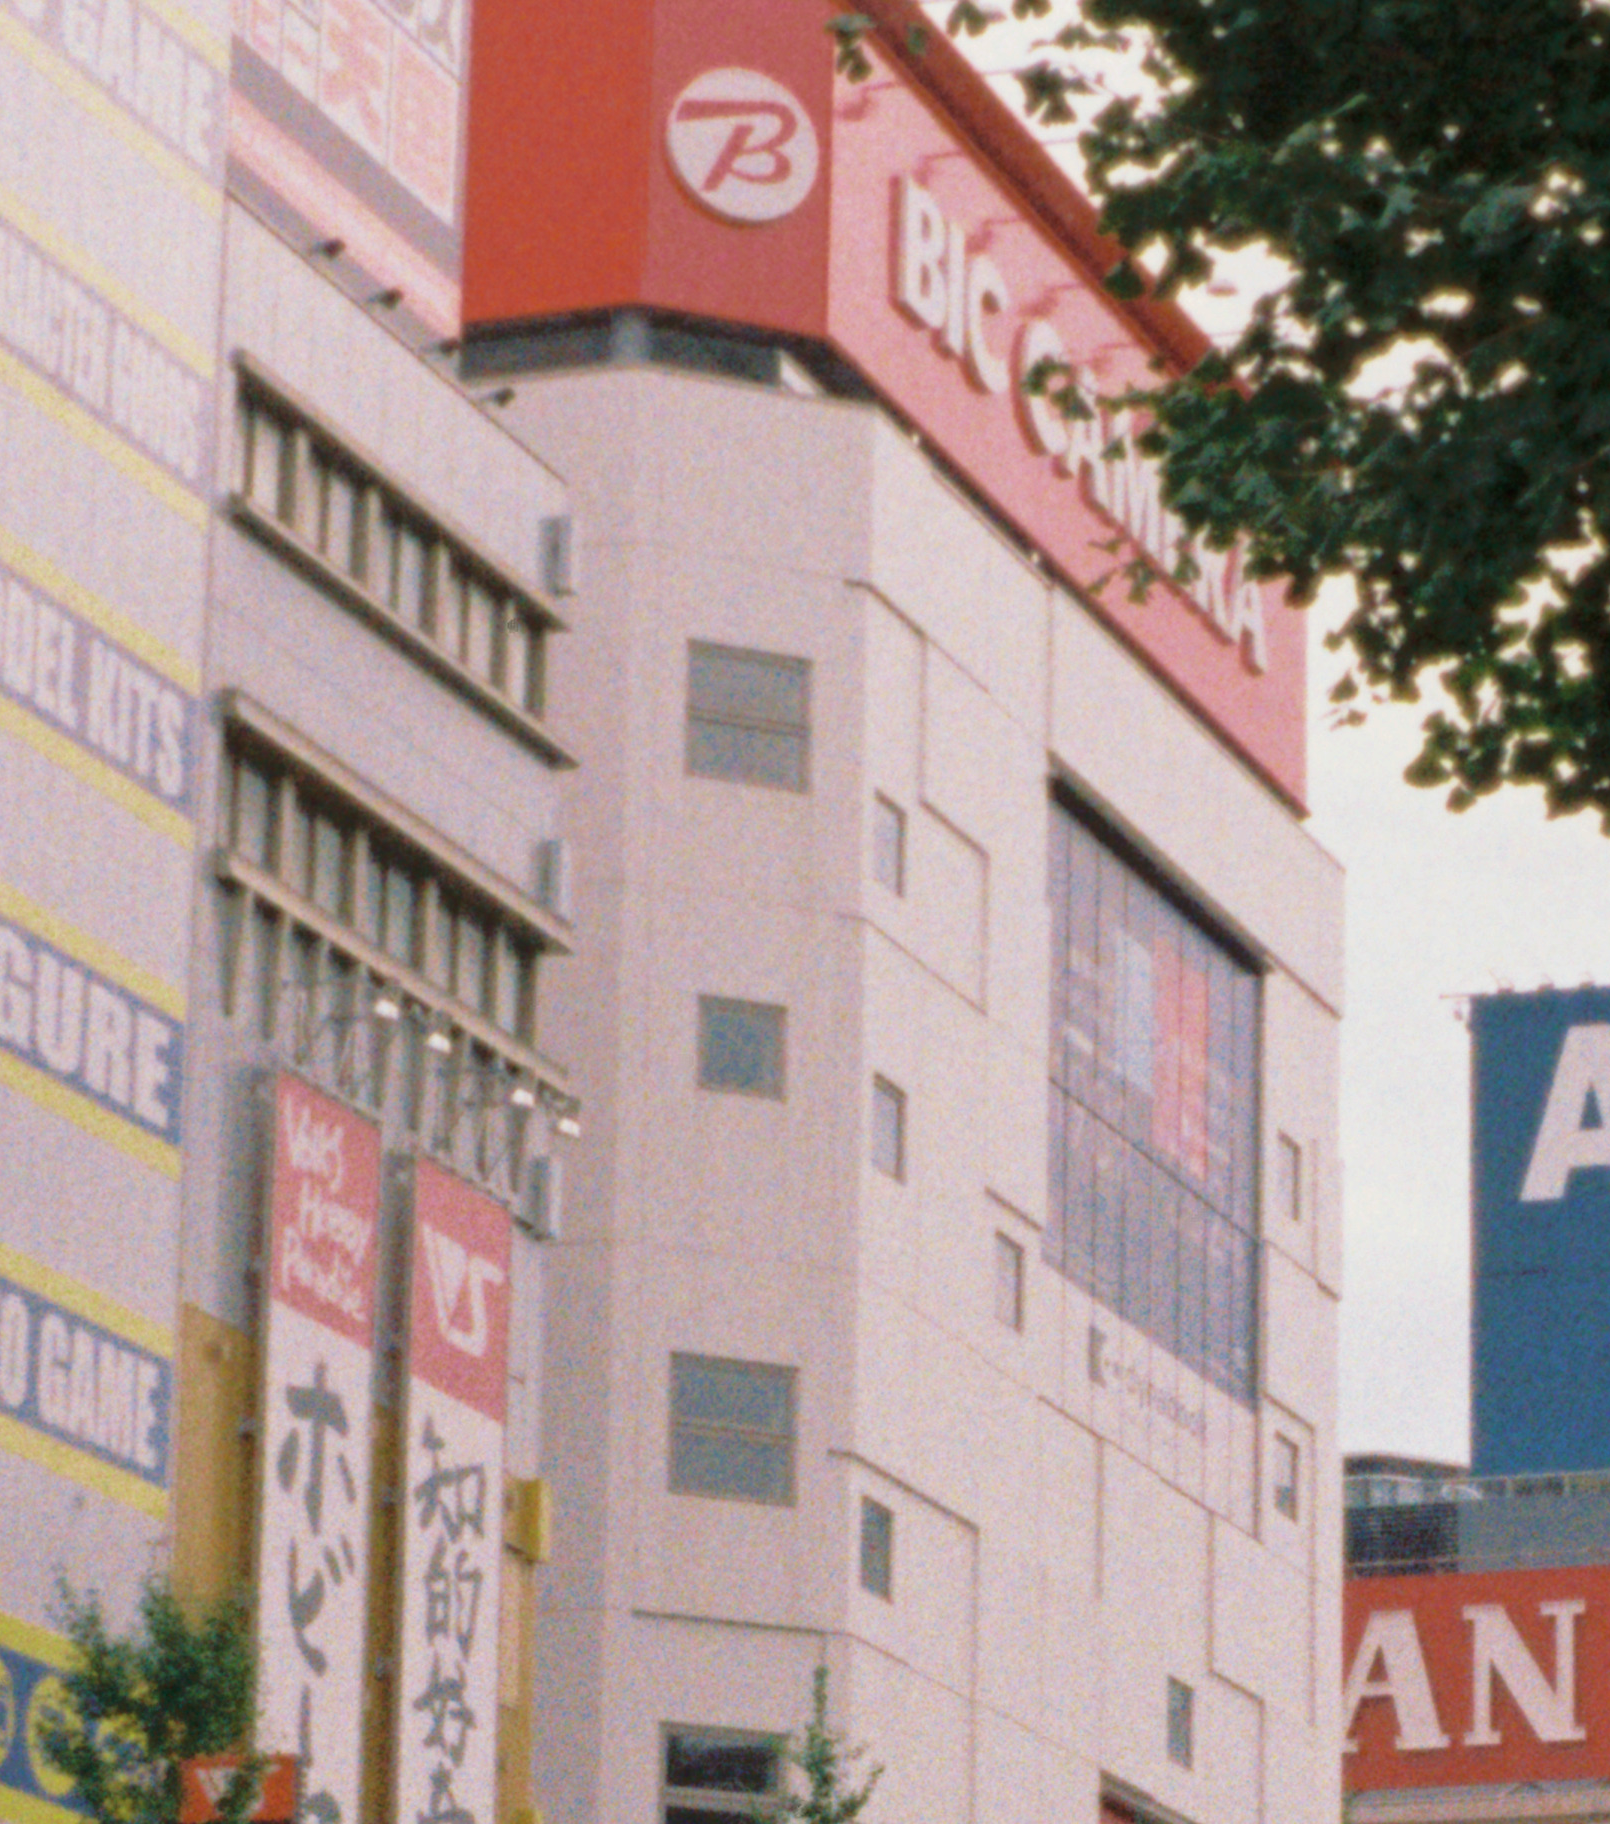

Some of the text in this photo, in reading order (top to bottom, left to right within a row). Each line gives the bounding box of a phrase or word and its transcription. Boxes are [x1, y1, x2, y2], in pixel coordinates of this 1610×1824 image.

[895, 174, 1008, 395] BIC
[87, 634, 185, 798] KITS
[38, 1309, 159, 1471] GAME
